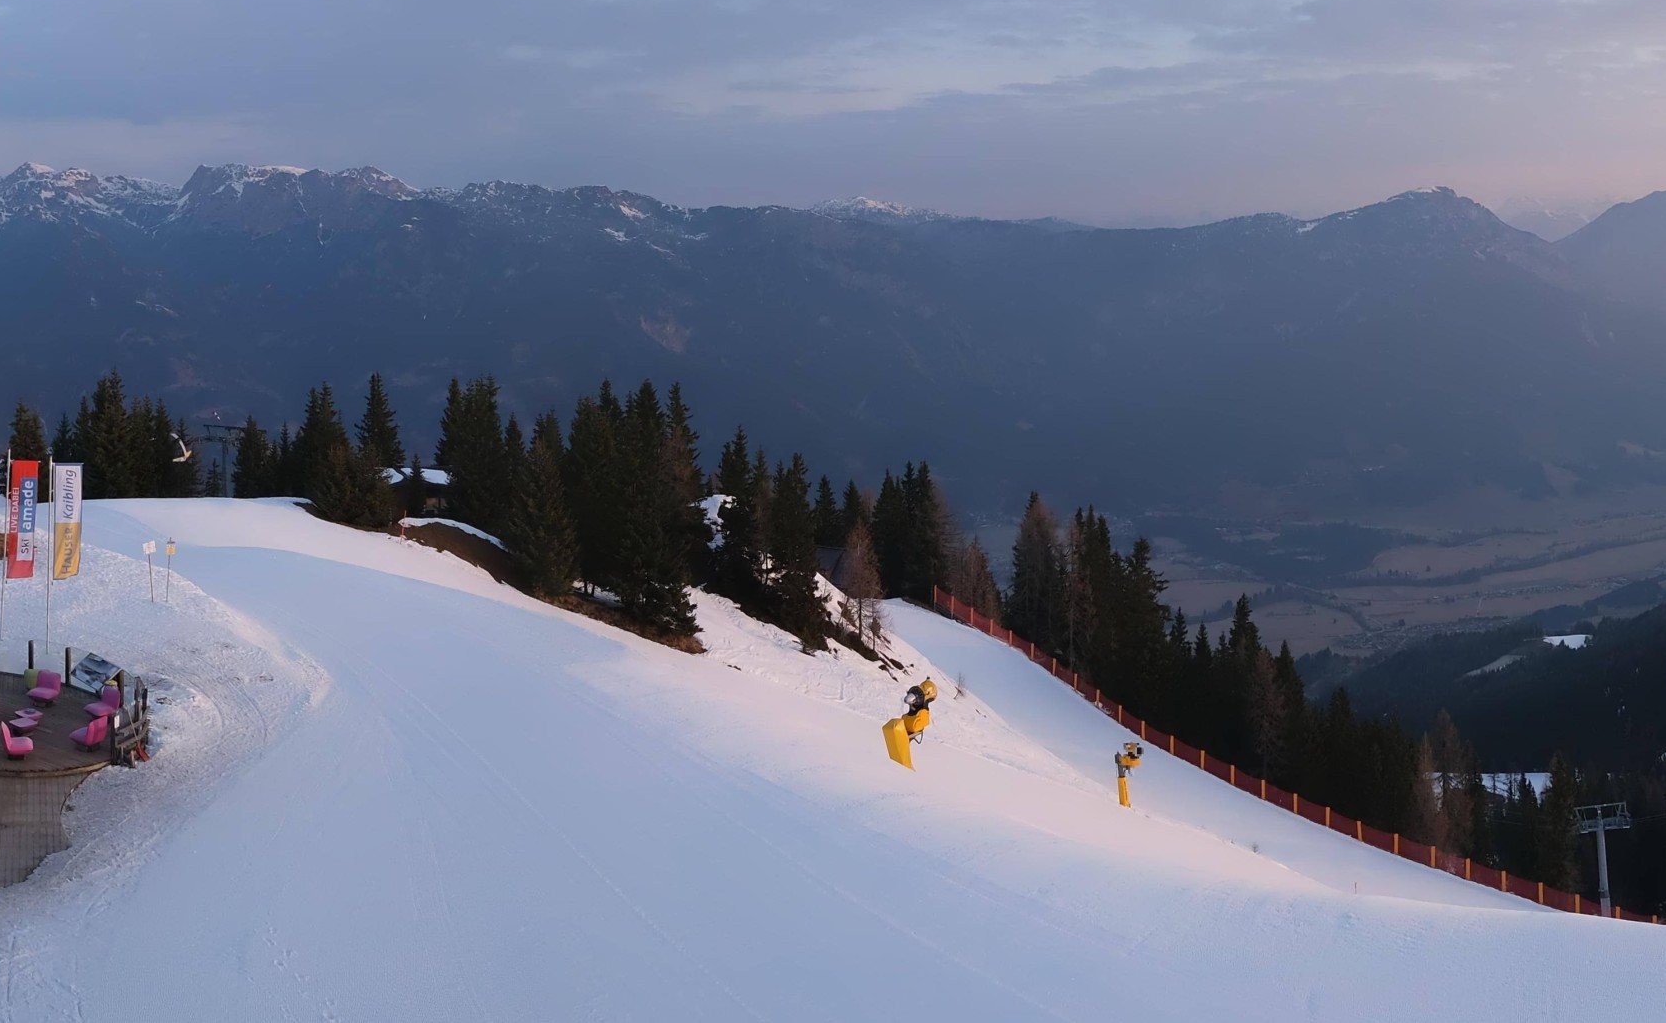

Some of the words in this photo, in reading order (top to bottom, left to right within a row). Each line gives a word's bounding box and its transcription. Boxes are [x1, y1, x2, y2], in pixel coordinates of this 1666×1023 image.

[11, 487, 20, 514] DABEI
[63, 469, 77, 519] Kaibling
[10, 514, 18, 533] LIVE
[21, 538, 29, 554] Ski
[61, 527, 75, 575] HAUSER
